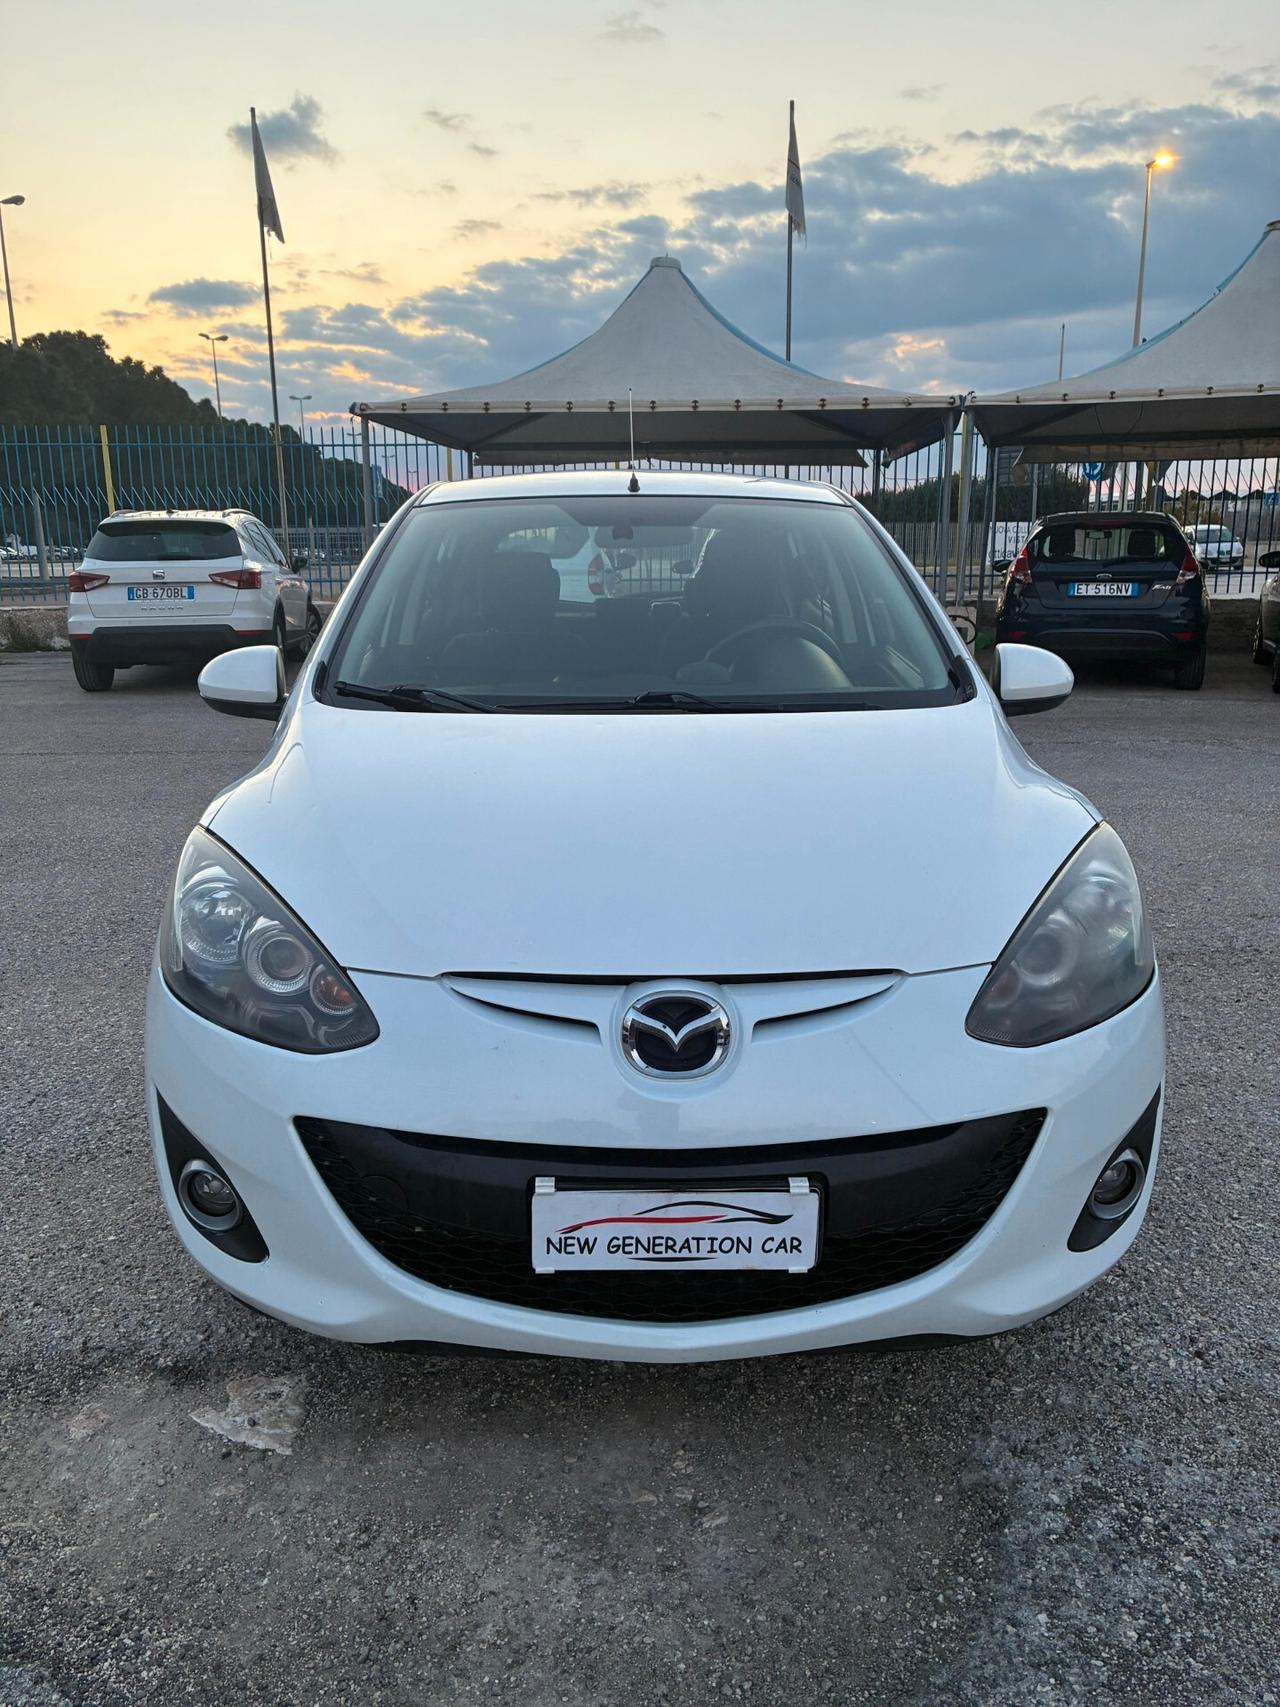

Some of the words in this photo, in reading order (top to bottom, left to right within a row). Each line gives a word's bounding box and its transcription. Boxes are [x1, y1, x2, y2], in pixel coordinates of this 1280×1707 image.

[546, 1236, 598, 1255] NEW
[607, 1236, 752, 1255] GENERATION
[761, 1236, 802, 1254] CAR
